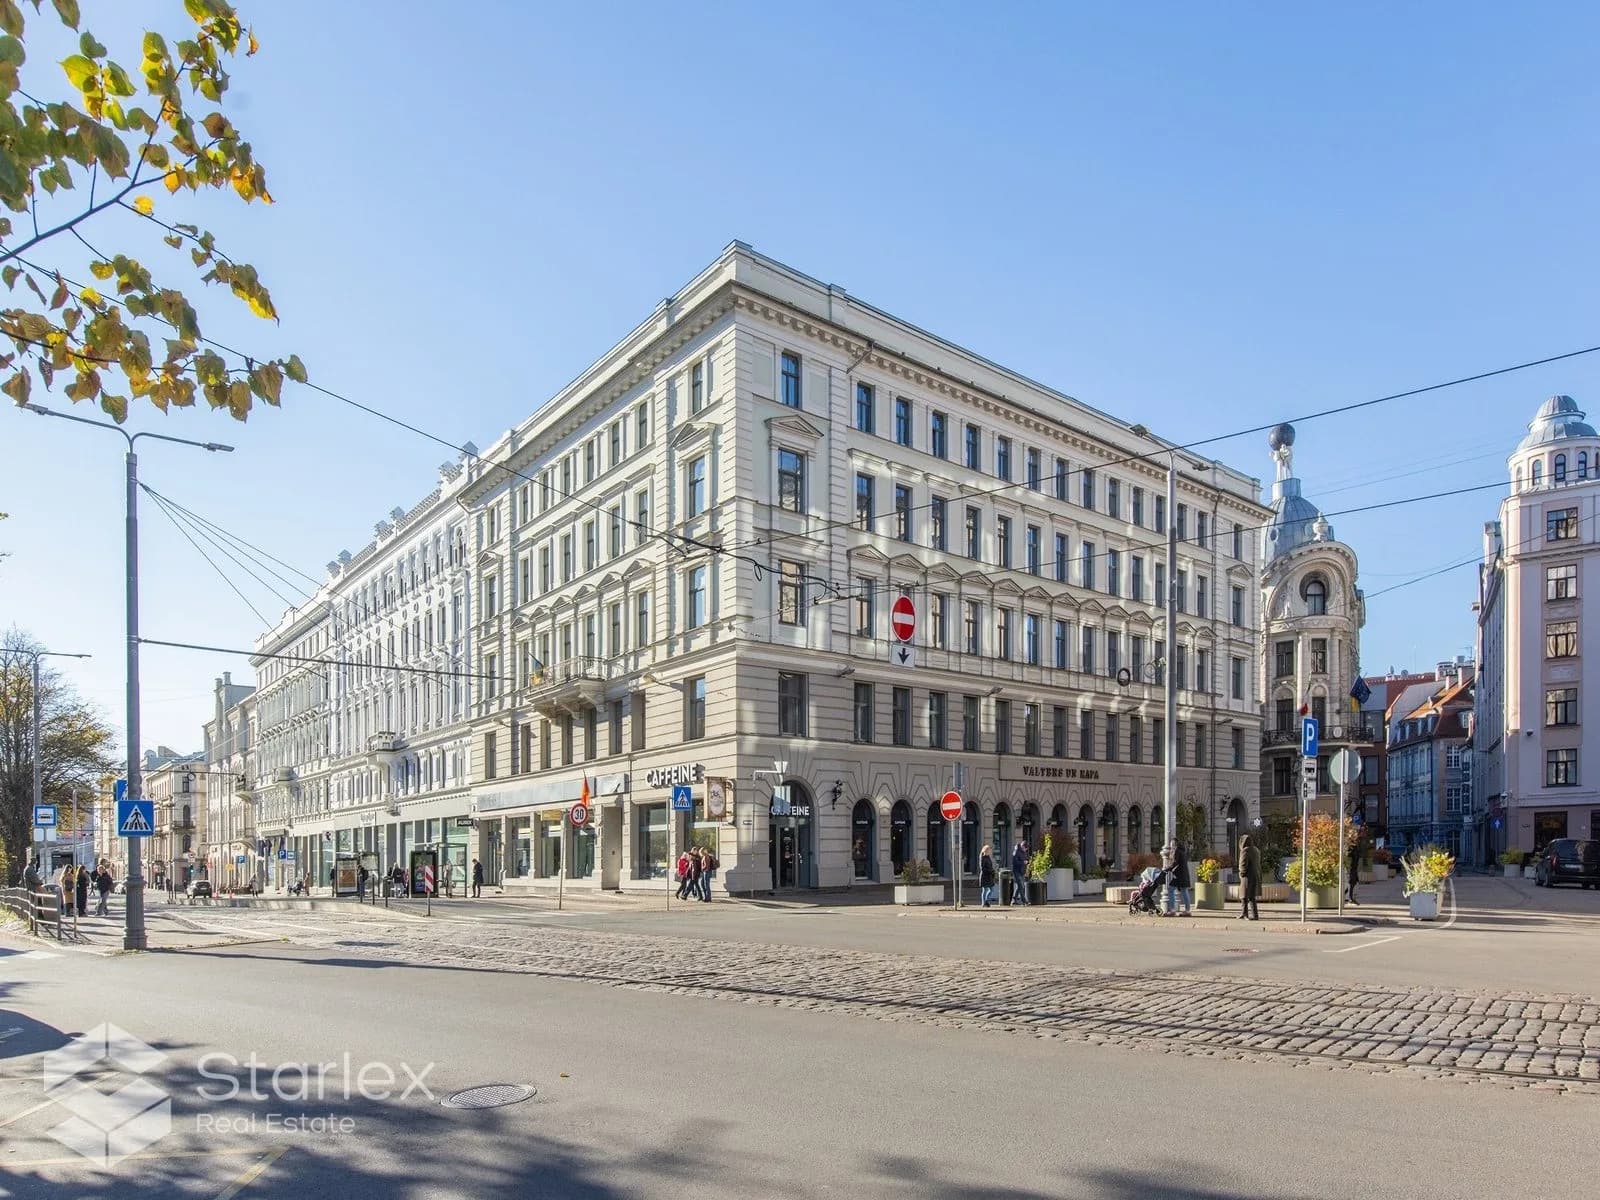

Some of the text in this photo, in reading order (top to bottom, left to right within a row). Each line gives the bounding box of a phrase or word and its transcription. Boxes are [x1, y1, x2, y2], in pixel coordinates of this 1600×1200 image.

[1306, 723, 1315, 751] P
[645, 763, 698, 787] CAFFEINE
[575, 809, 584, 820] 30
